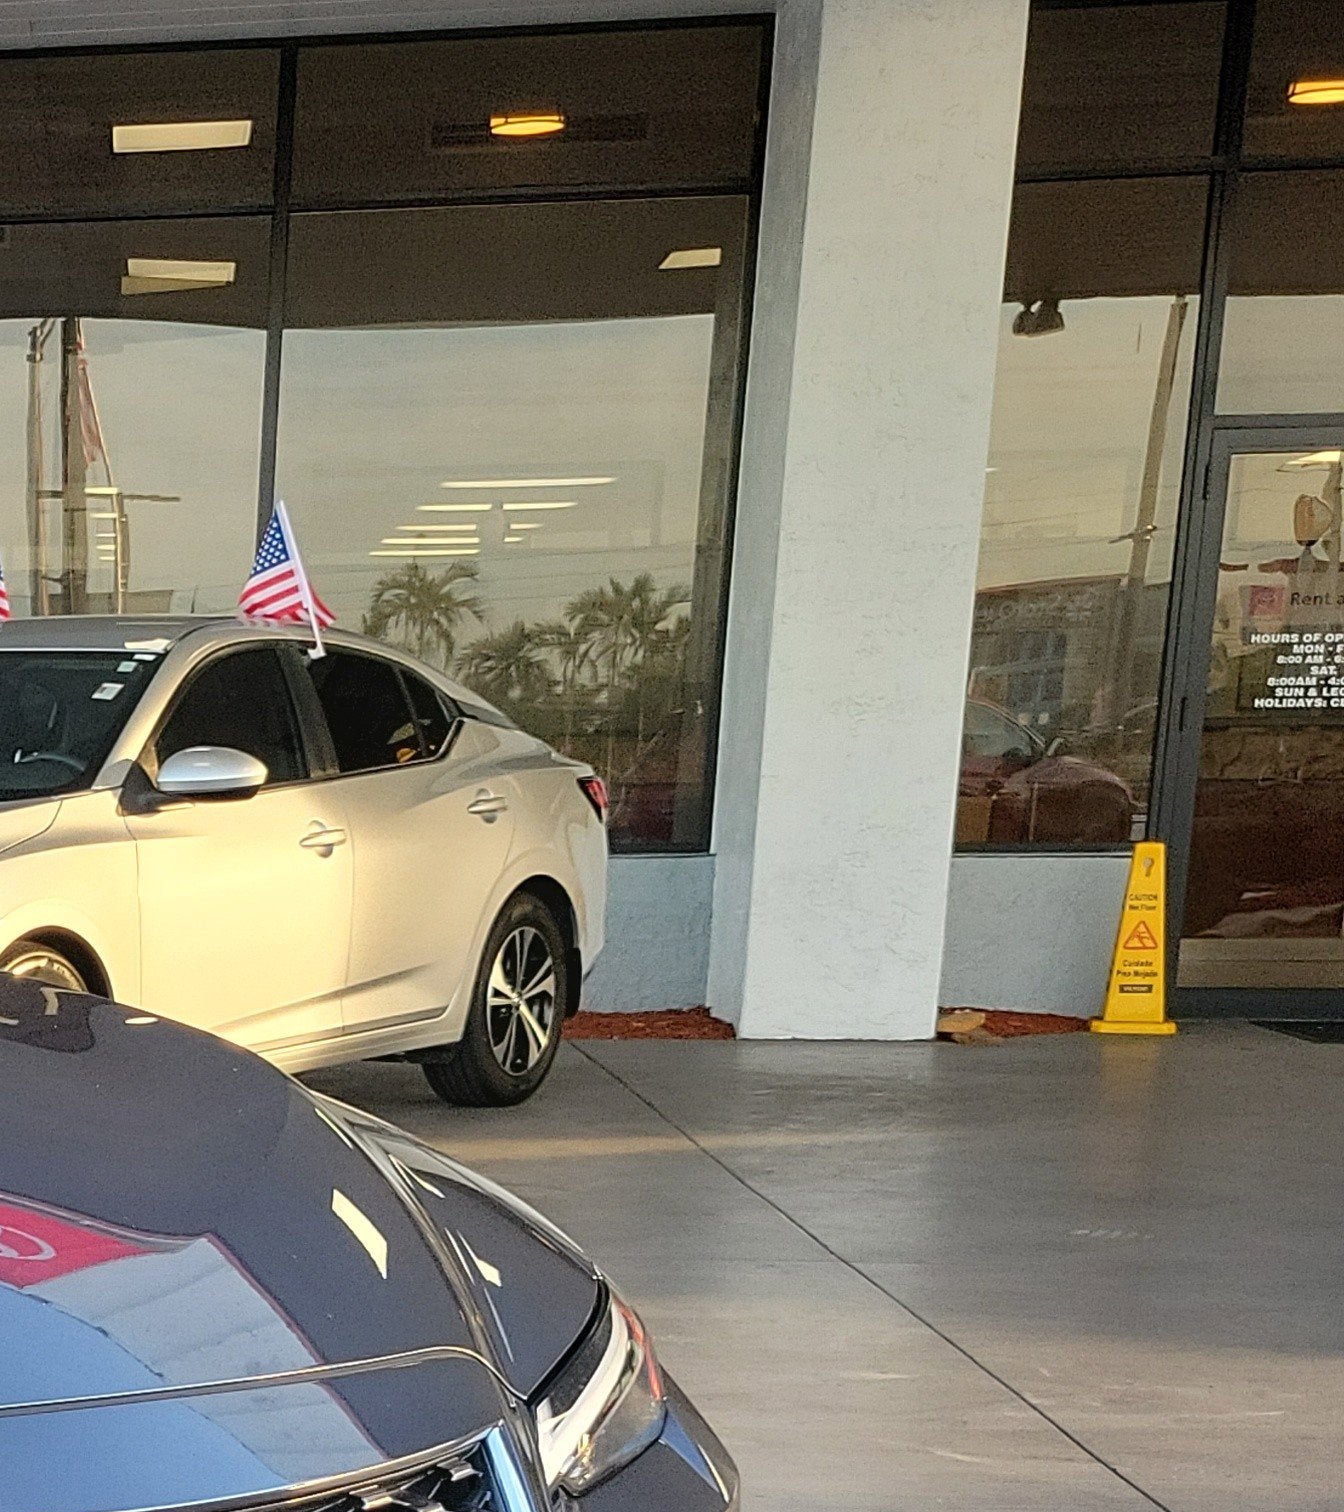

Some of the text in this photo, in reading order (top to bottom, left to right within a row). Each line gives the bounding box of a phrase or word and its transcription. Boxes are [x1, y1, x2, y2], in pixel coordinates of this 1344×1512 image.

[1290, 592, 1332, 606] Rent
[1251, 633, 1344, 643] HOURS OF OP
[1293, 644, 1325, 654] MON
[1276, 655, 1302, 664] 8:00
[1304, 655, 1324, 664] AM
[1310, 665, 1337, 675] SAT.
[1267, 677, 1317, 686] 8:00AM
[1275, 687, 1304, 697] SUN
[1307, 687, 1317, 697] &
[1254, 698, 1327, 708] HOLIDAYS:
